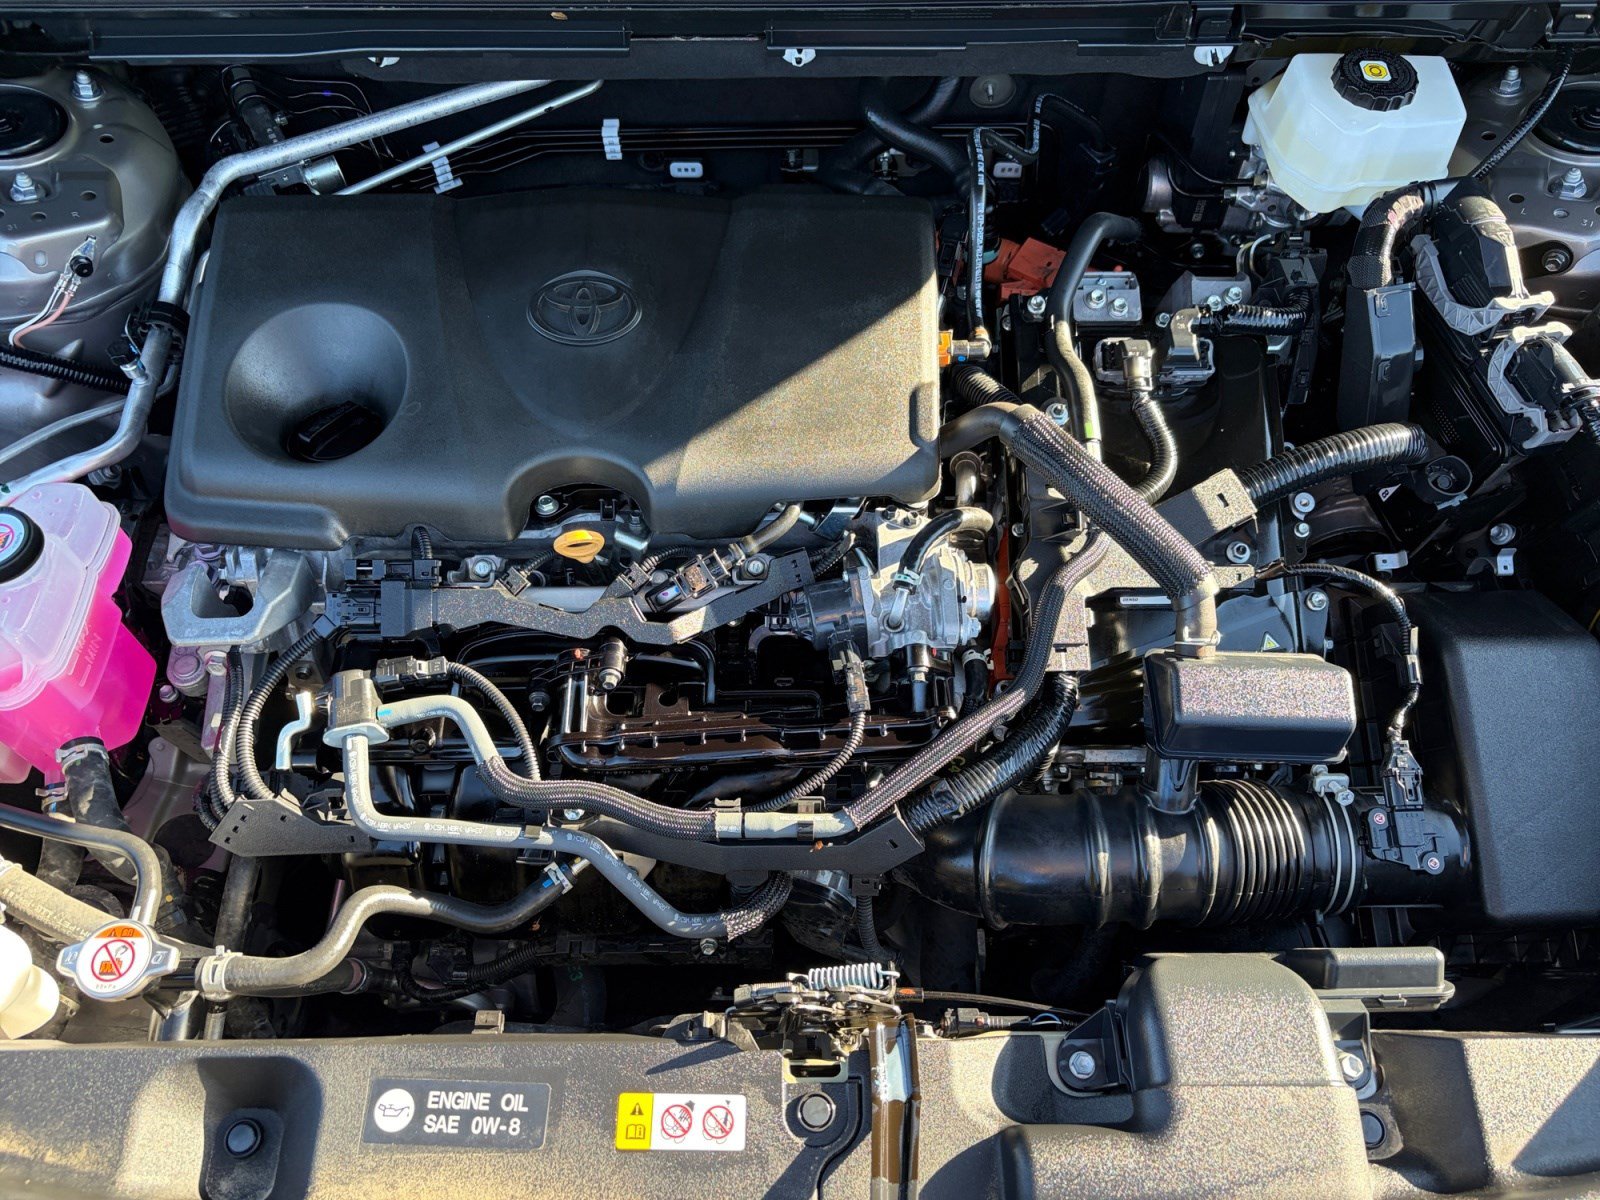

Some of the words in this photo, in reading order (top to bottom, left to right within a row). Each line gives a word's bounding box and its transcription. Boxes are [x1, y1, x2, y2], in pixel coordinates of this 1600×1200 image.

[427, 1090, 492, 1111] ENGINE
[500, 1092, 529, 1113] OIL
[423, 1113, 461, 1134] SAE
[471, 1115, 521, 1136] 0W-8
